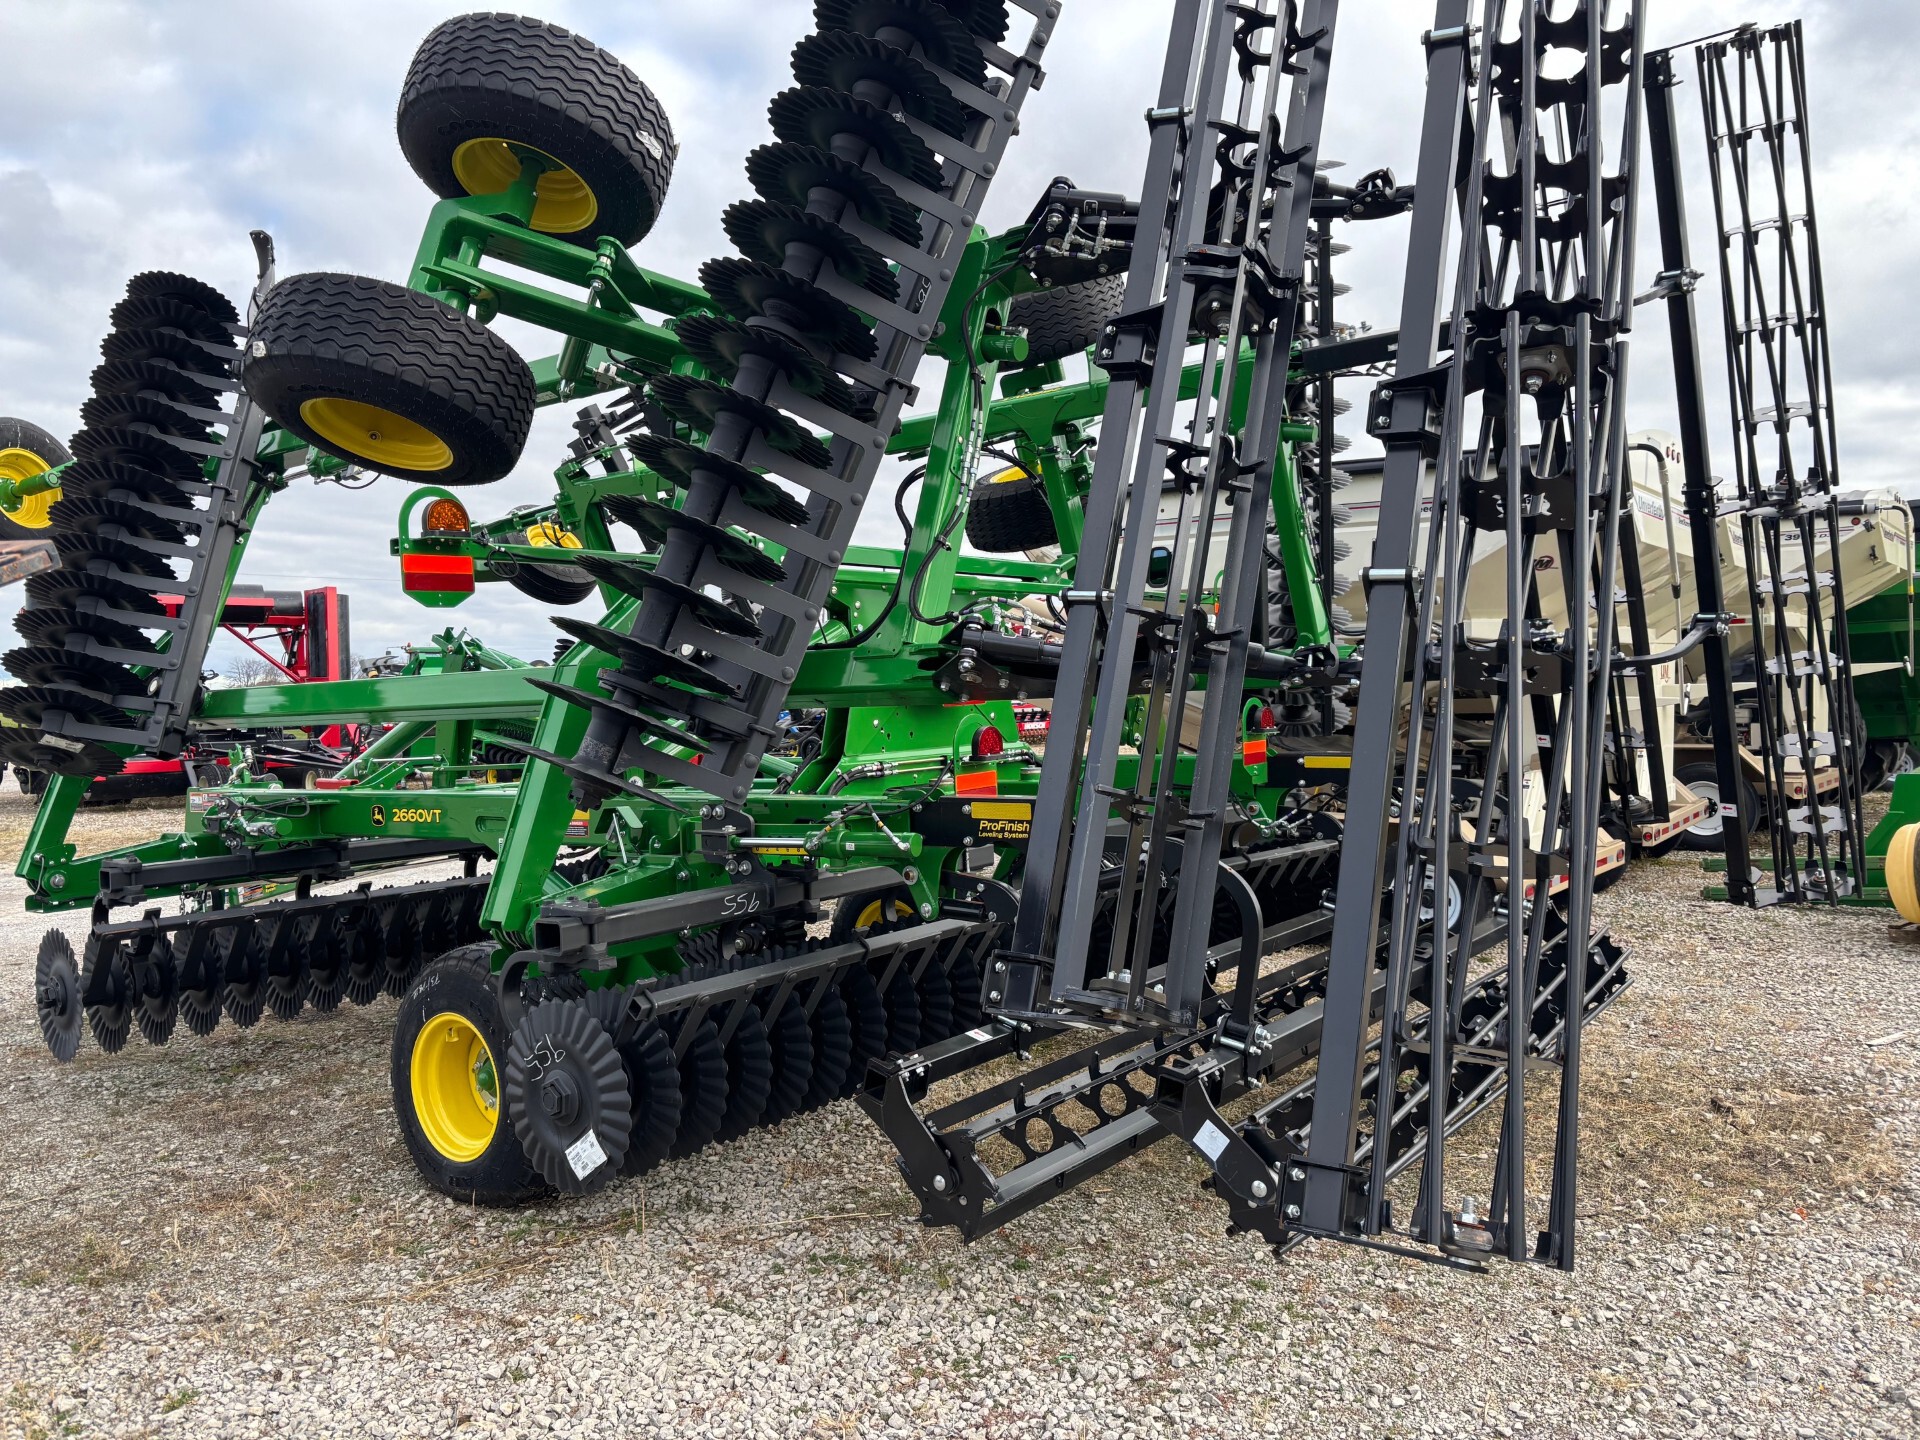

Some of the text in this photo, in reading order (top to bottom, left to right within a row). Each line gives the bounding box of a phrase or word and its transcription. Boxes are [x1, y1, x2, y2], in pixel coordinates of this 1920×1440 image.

[392, 808, 442, 823] 2660VT
[979, 820, 1030, 832] ProFinish
[978, 831, 1029, 839] Leveling System
[721, 892, 760, 915] 556
[524, 1033, 566, 1082] 556
